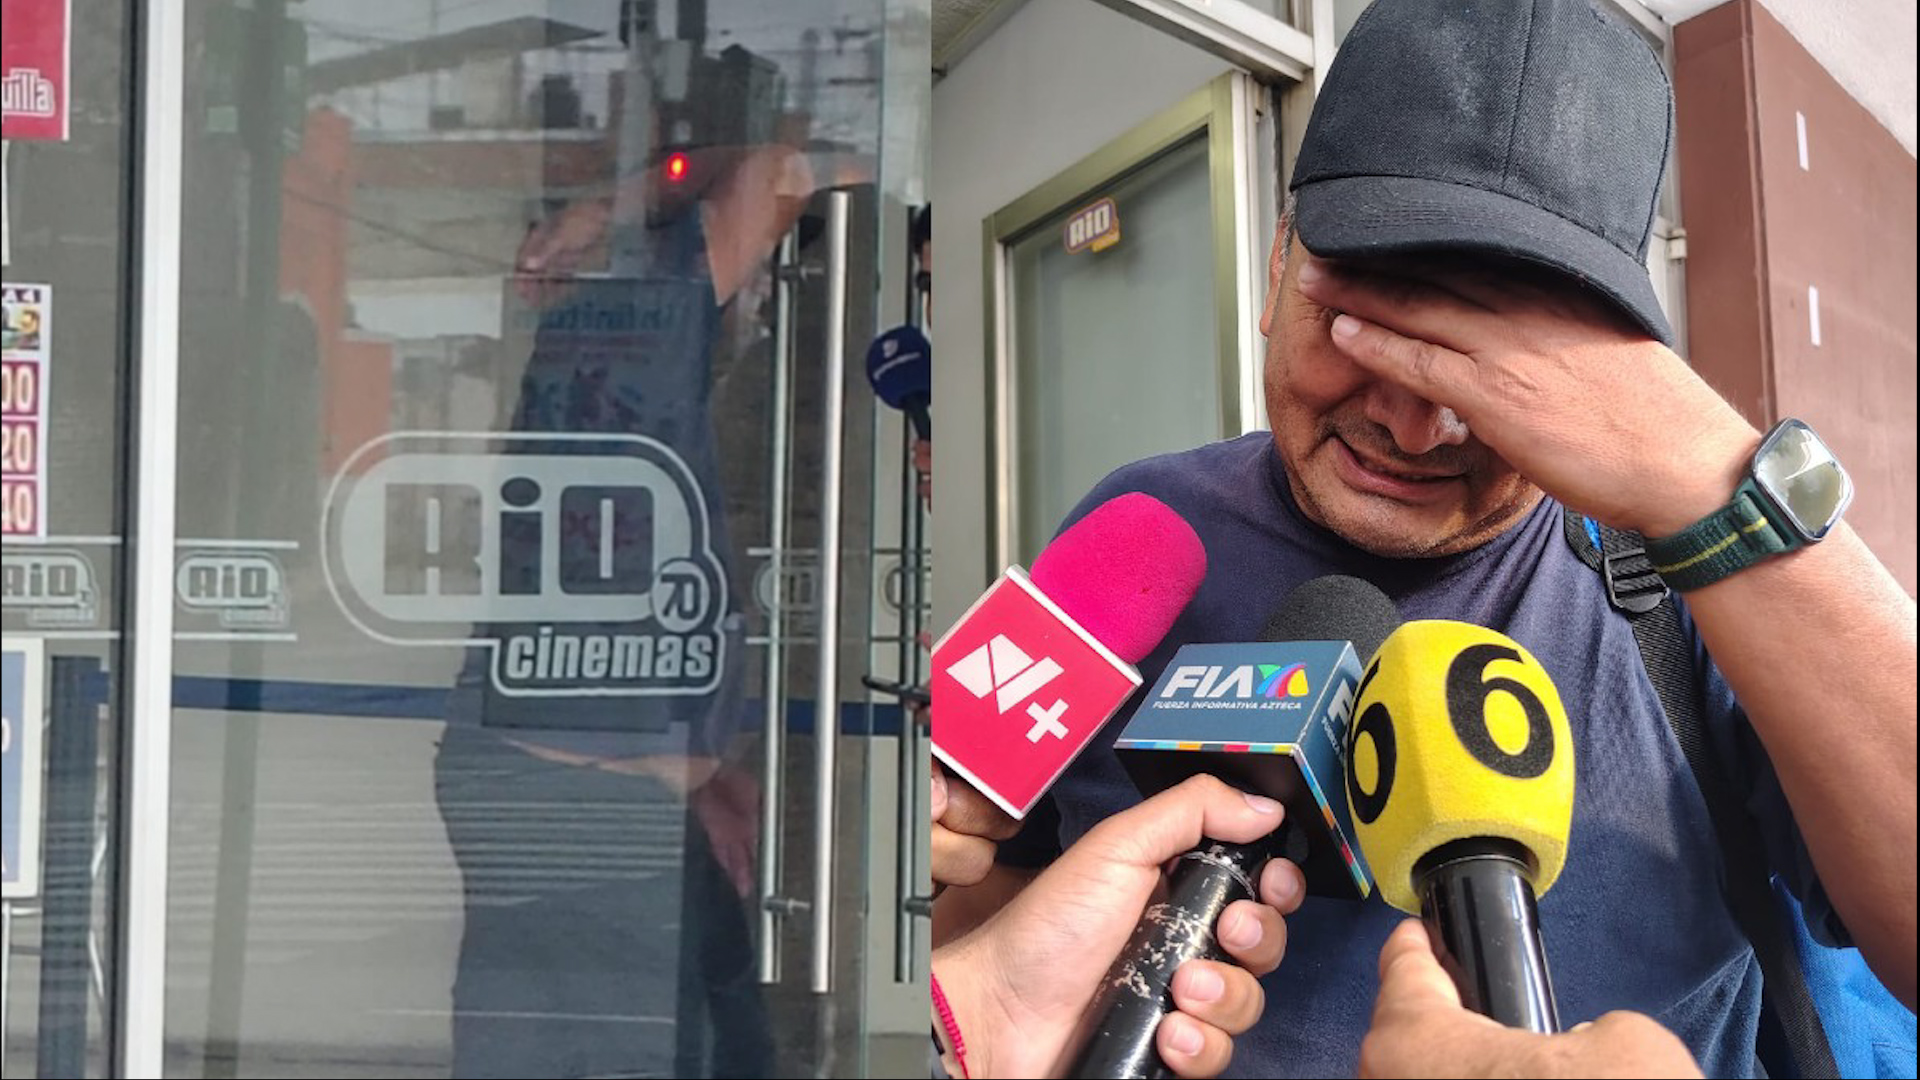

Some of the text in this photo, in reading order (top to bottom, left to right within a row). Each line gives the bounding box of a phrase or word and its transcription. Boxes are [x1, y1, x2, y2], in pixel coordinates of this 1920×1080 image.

[505, 626, 713, 679] cinemas
[1152, 700, 1302, 711] FUERZA INFORMATIVA AZTECA
[1159, 664, 1254, 698] FIA
[1445, 643, 1555, 779] 6
[1347, 656, 1397, 825] 6
